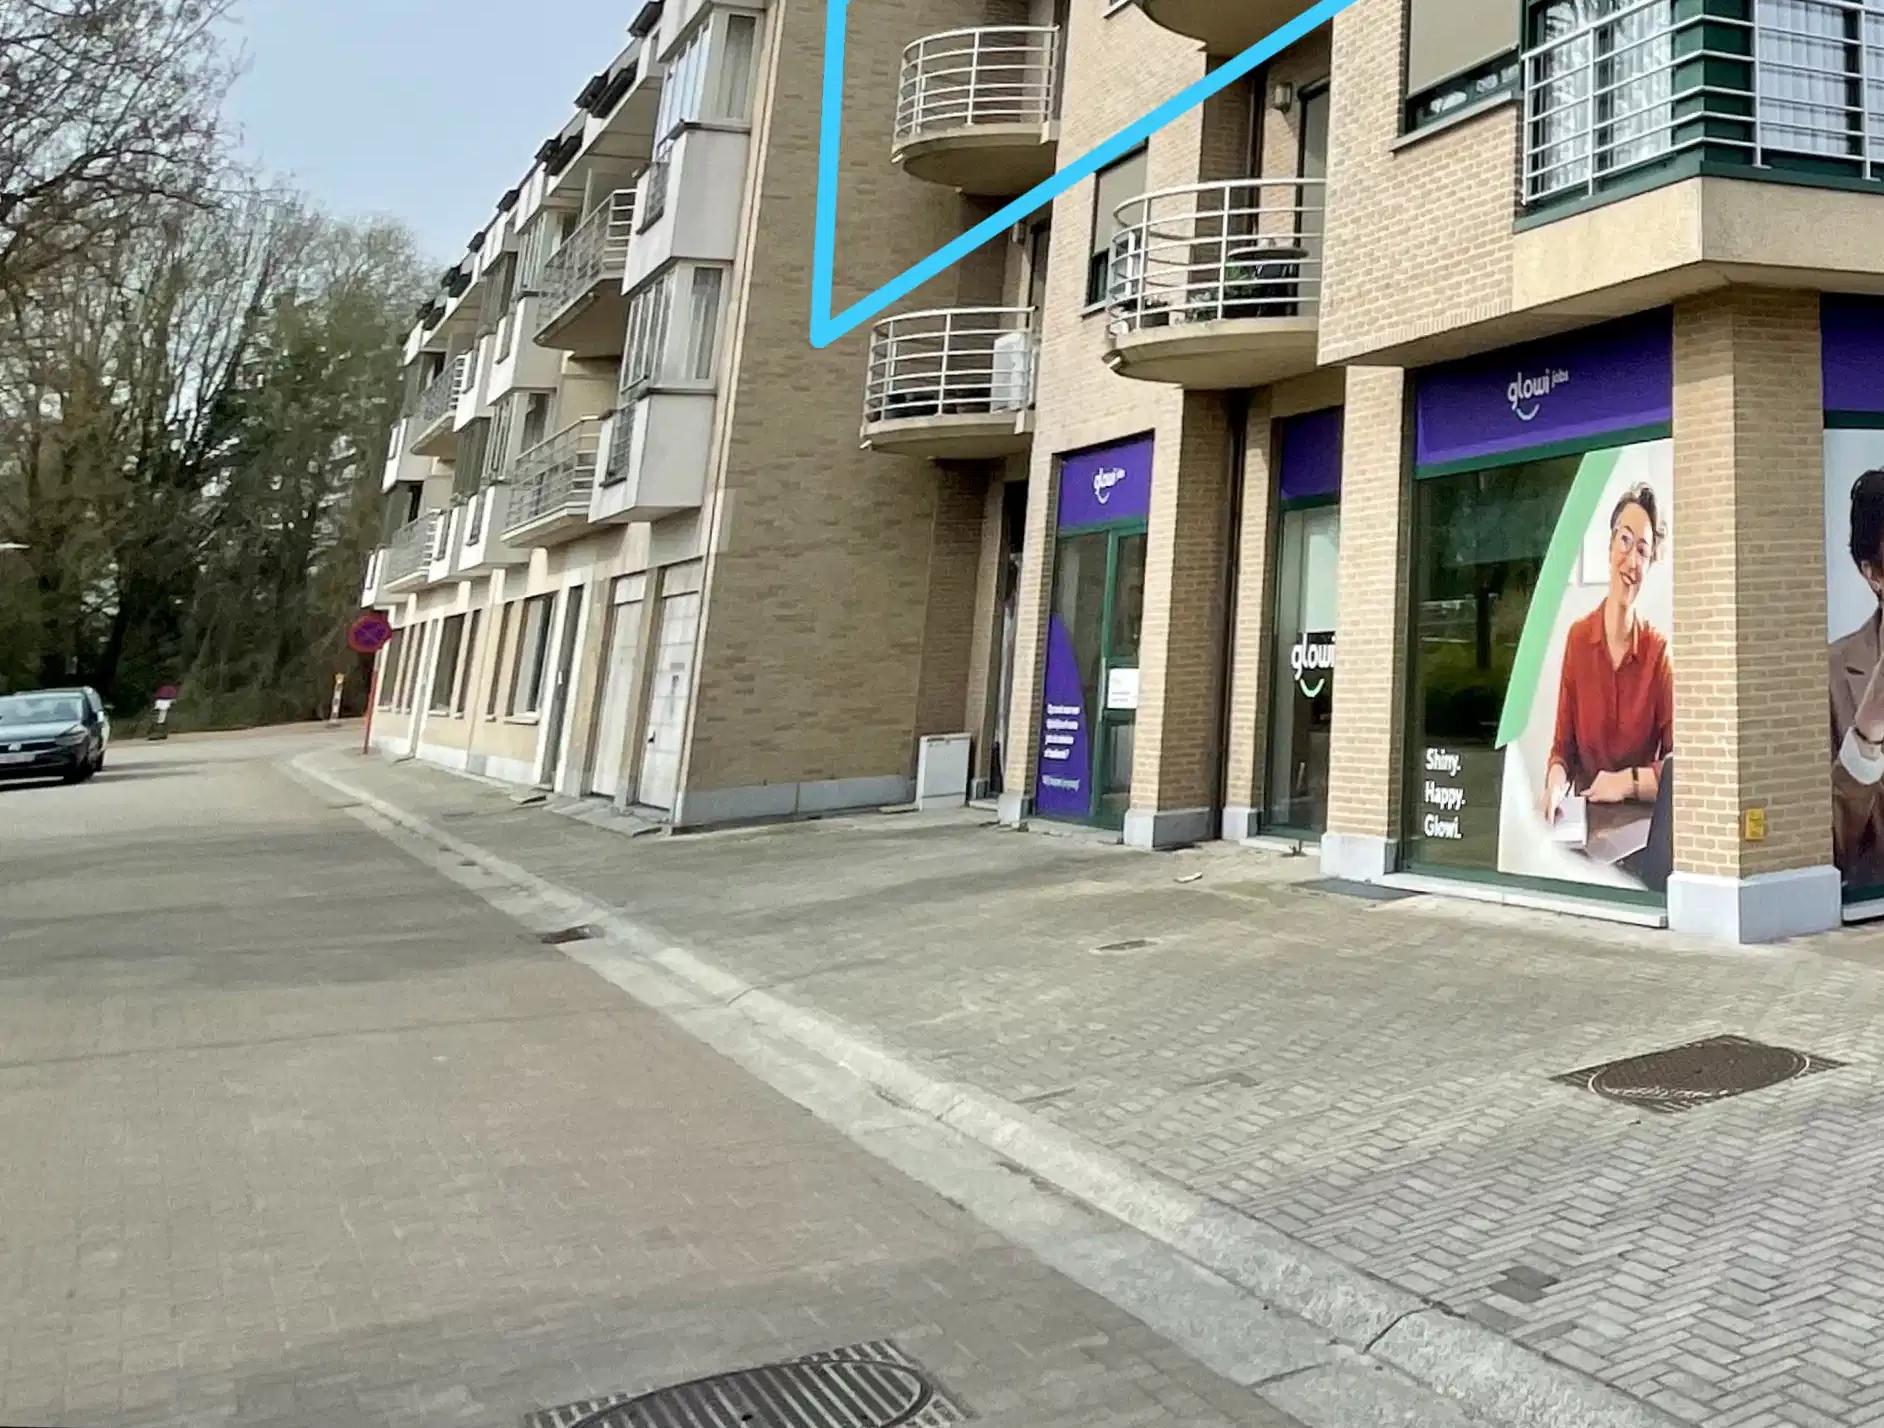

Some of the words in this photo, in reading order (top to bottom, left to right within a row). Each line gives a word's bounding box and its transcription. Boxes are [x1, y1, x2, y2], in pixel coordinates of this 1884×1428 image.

[1507, 368, 1550, 411] glowi
[1291, 632, 1336, 681] glowi
[1425, 748, 1461, 776] Shiny.
[1425, 780, 1466, 810] Happy.
[1424, 813, 1462, 839] Glowi.
